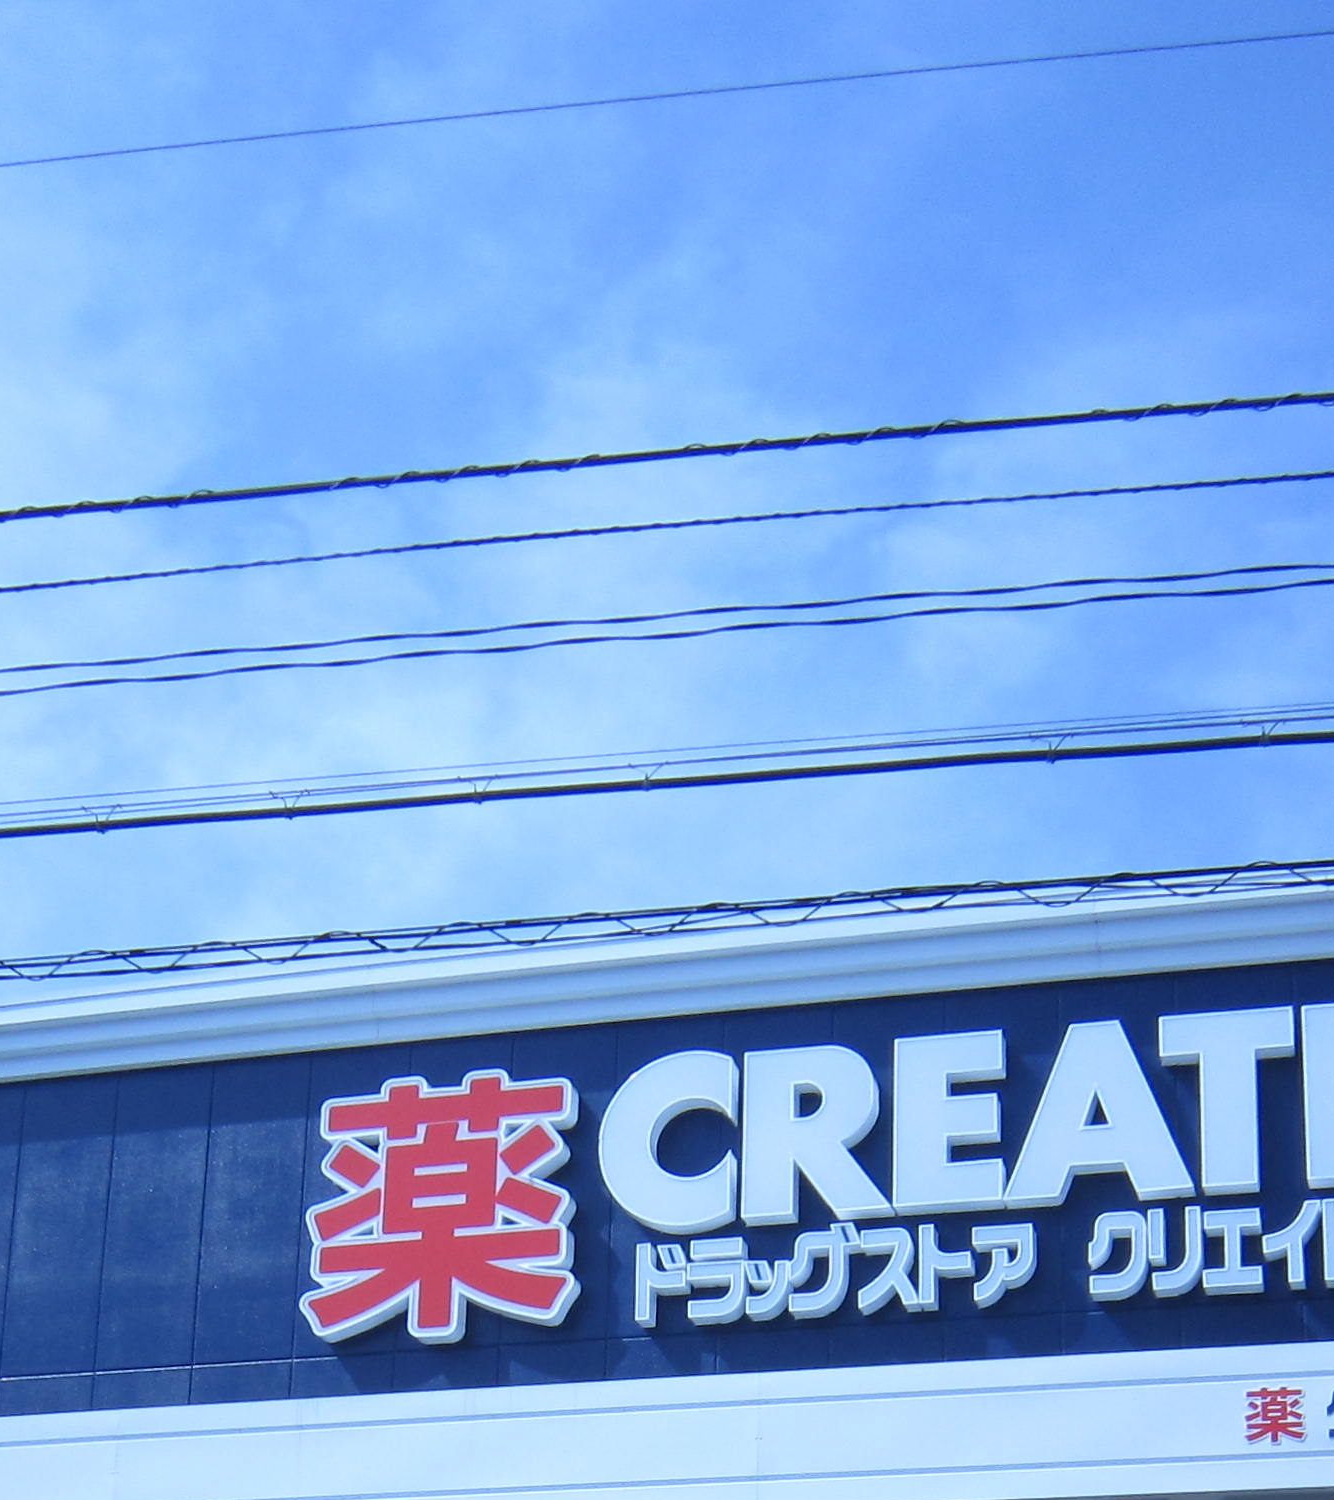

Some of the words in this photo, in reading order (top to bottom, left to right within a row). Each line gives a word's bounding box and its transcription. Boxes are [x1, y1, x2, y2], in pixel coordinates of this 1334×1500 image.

[299, 1068, 579, 1344] 薬
[634, 1220, 1037, 1329] ドラッグストア
[1242, 1386, 1309, 1446] 薬
